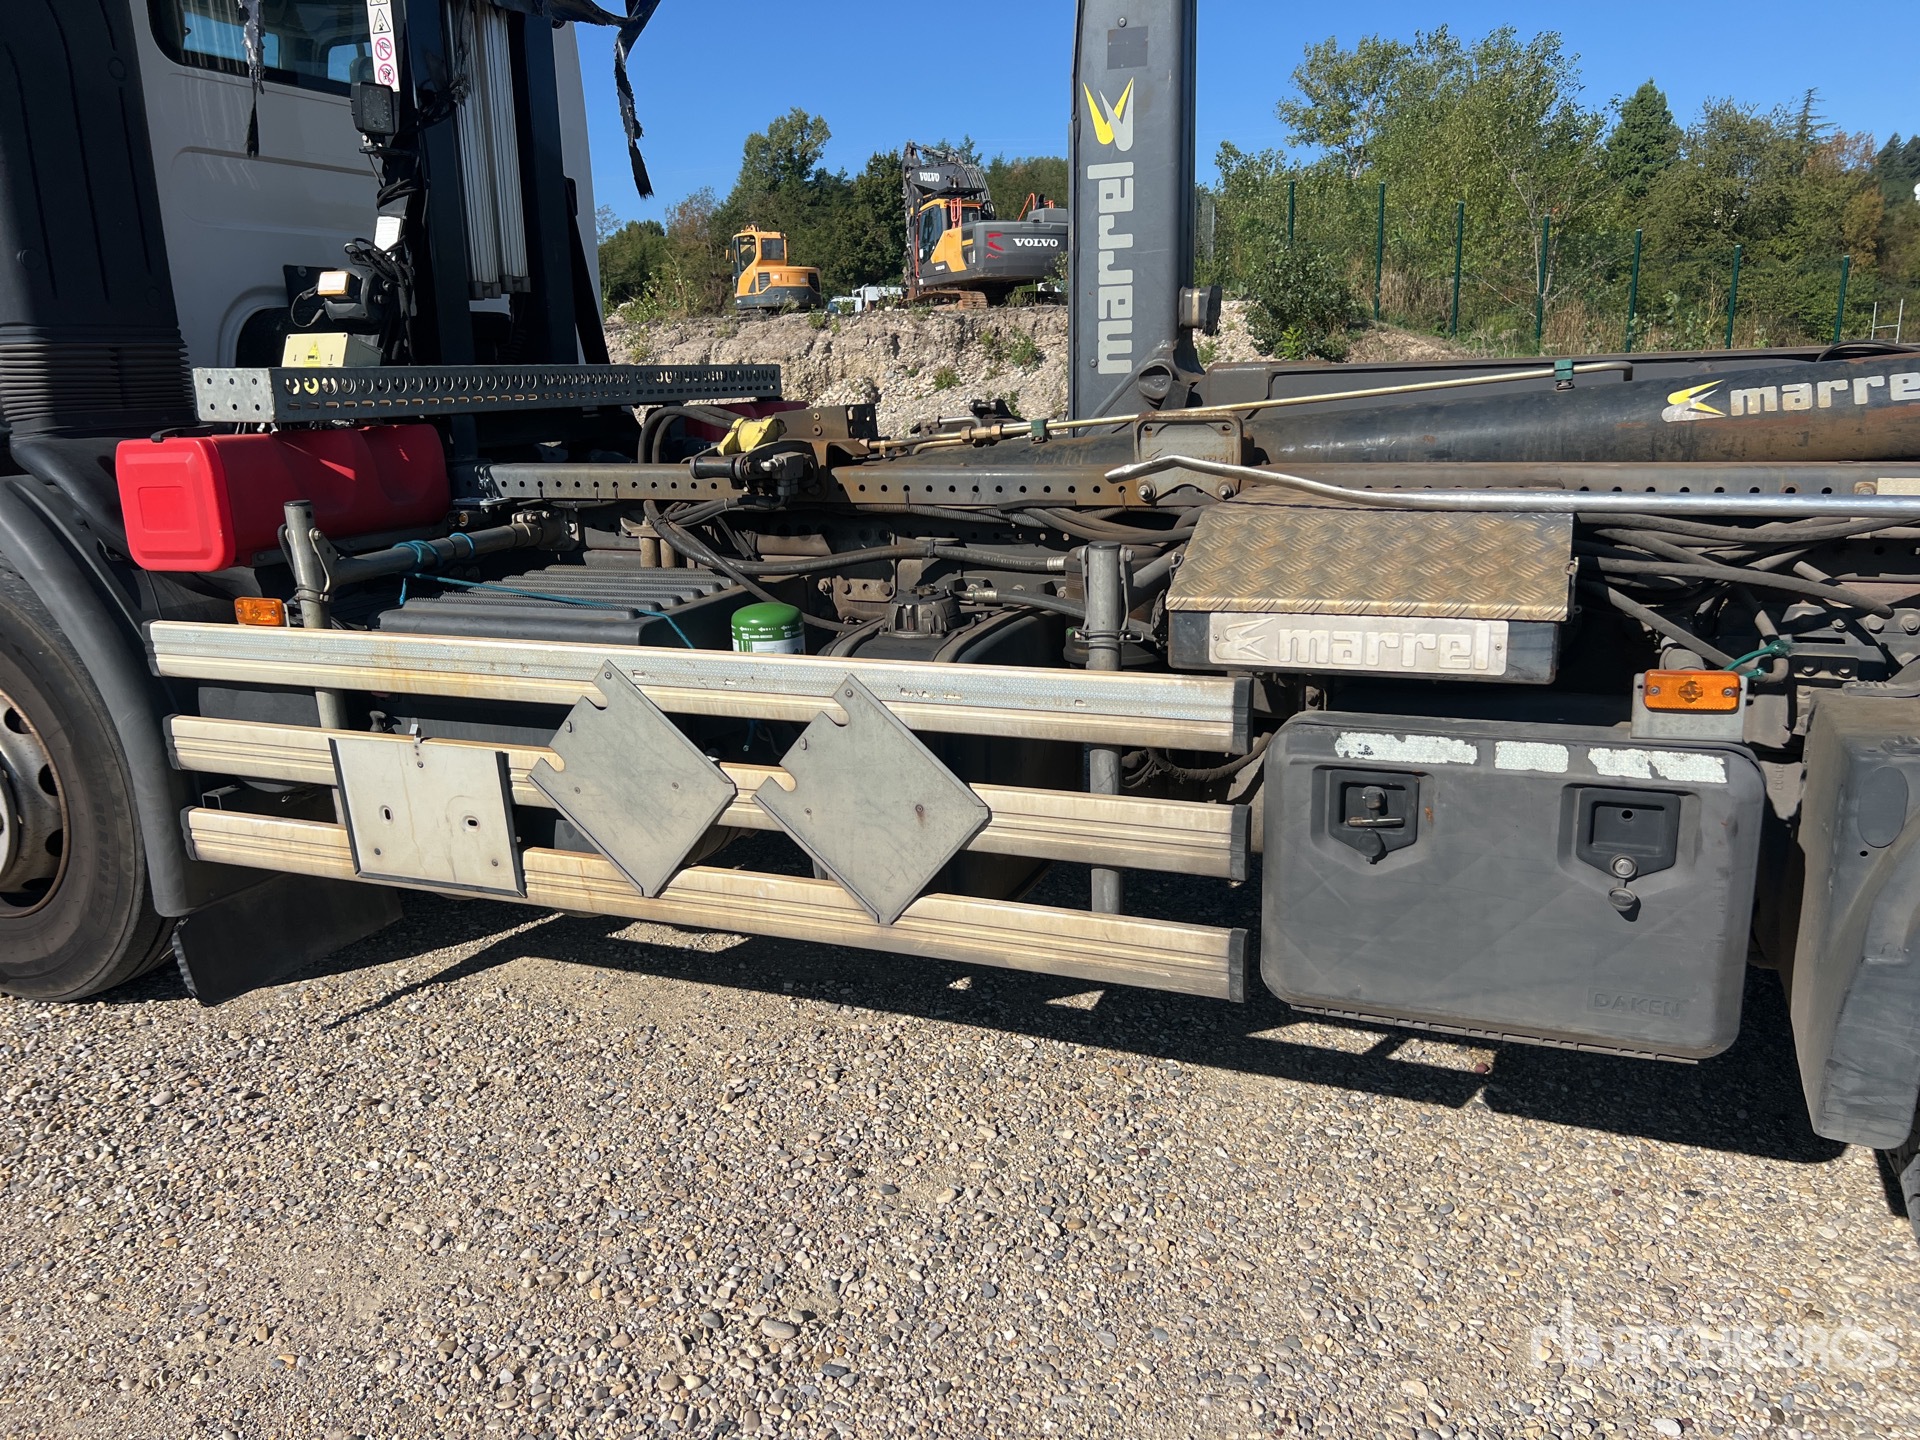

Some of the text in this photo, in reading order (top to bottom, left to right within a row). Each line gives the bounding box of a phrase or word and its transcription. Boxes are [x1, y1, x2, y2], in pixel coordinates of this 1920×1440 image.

[919, 172, 940, 182] VOLVO
[1013, 238, 1059, 247] VOLVO
[1087, 161, 1134, 374] marrel
[1278, 623, 1492, 670] marrel
